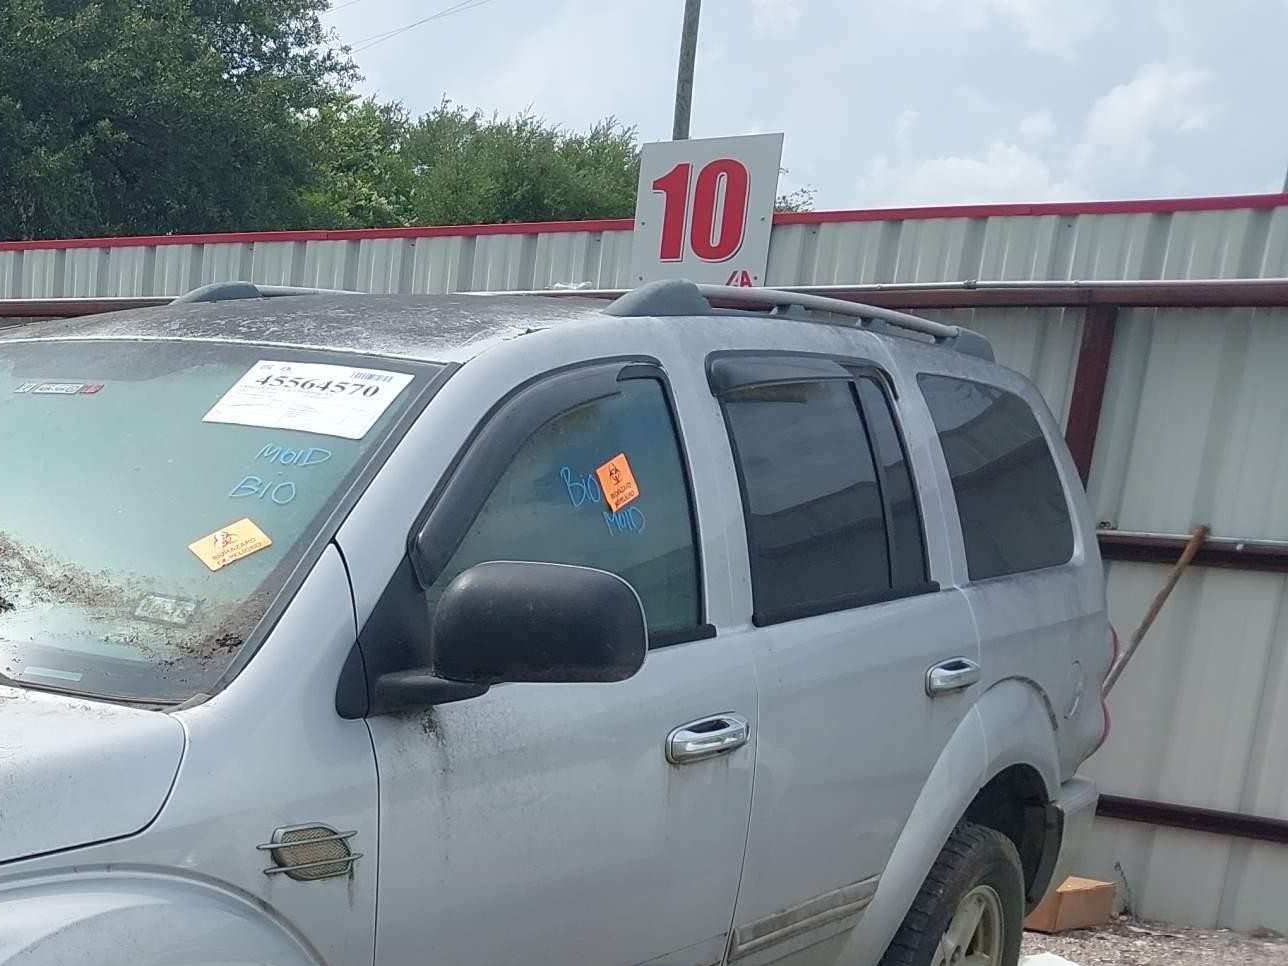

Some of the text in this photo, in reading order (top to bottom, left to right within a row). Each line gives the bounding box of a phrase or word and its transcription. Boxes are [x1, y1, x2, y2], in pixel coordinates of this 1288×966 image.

[651, 157, 750, 263] 10
[255, 374, 380, 398] 45564570
[228, 475, 297, 504] BIO
